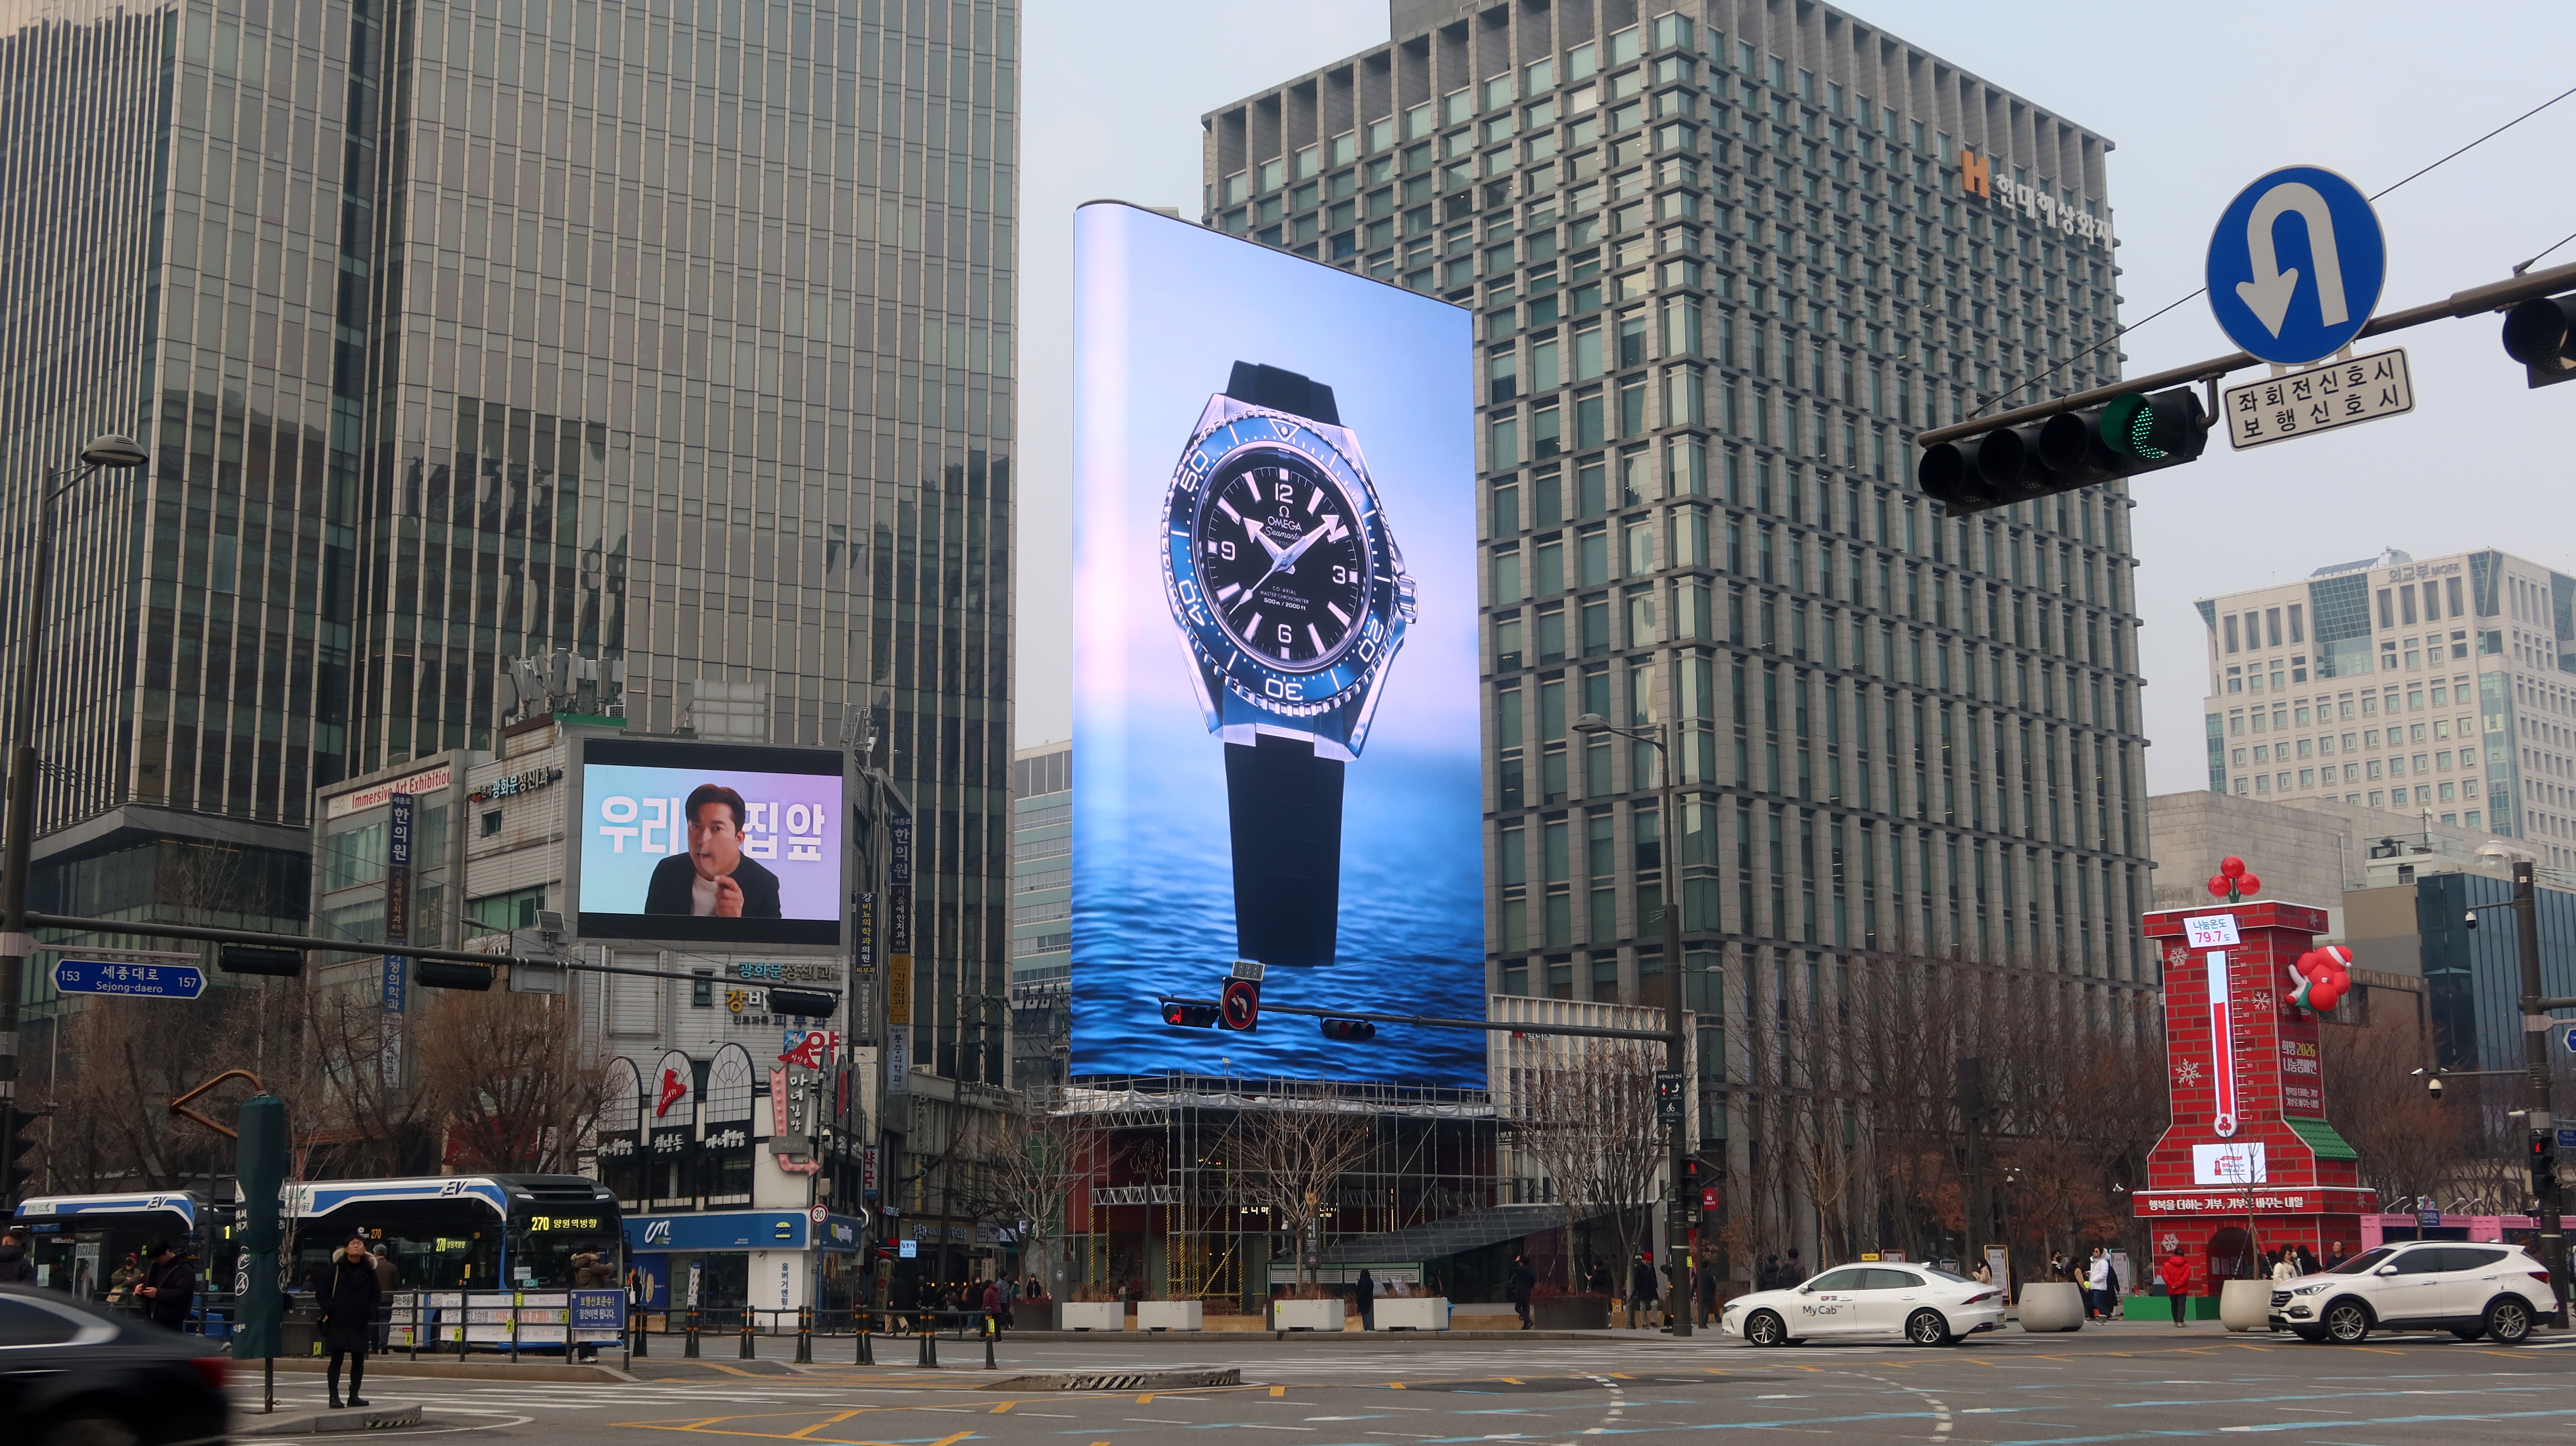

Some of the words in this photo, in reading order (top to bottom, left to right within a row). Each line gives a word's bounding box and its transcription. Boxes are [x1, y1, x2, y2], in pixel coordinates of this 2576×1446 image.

[1996, 171, 2113, 254] 현대해상화재
[1180, 448, 1209, 493] 50
[1275, 482, 1293, 504] 12
[1268, 516, 1302, 532] OMEGA
[1264, 526, 1300, 540] Seamaste
[1221, 540, 1235, 560] 9
[1332, 565, 1346, 585] 3
[2388, 563, 2429, 583] 외교부
[2431, 562, 2461, 577] MOFA
[1178, 578, 1206, 627] 40
[1278, 593, 1309, 604] CHRONOMETER
[1278, 624, 1292, 644] 6
[1358, 618, 1384, 663] 20
[1265, 678, 1303, 701] 30
[352, 787, 392, 809] Immersive
[395, 780, 407, 794] Art
[393, 797, 411, 805] 세종로
[599, 796, 680, 855] 우리
[393, 808, 410, 861] 한의원
[894, 828, 910, 878] 한의원
[2193, 919, 2227, 931] 나눔온도
[2195, 931, 2222, 943] 79.7
[61, 970, 80, 981] 153
[101, 966, 159, 981] 세종대로
[96, 981, 162, 994] Sejong-daero
[178, 977, 197, 988] 157
[773, 1014, 827, 1029] 피부과
[2282, 1040, 2295, 1056] 희망
[2296, 1043, 2316, 1057] 2026
[894, 1034, 902, 1083] 통증의학과
[2283, 1058, 2317, 1075] 나눔캠페인
[2286, 1086, 2297, 1096] 행복을
[789, 1073, 808, 1131] 마녀김밥
[654, 1133, 684, 1153] 청담동
[864, 1149, 875, 1188] 약국
[445, 1181, 468, 1195] EV
[148, 1196, 167, 1209] EV
[2149, 1199, 2175, 1211] 행복을
[2176, 1199, 2203, 1210] 더하는
[2204, 1199, 2226, 1210] 기부,
[2227, 1198, 2254, 1209] 기부로
[2255, 1197, 2283, 1208] 바꾸는
[2285, 1197, 2303, 1208] 내일
[814, 1210, 824, 1219] 30
[531, 1217, 549, 1231] 270
[553, 1218, 597, 1229] 양원역방향
[370, 1229, 382, 1239] 270
[436, 1238, 446, 1252] 270
[447, 1240, 466, 1250] 양원역방향
[580, 1296, 614, 1307] 보행신호준수!
[579, 1309, 598, 1319] 잠깐이면
[1803, 1306, 1817, 1316] My
[1819, 1305, 1836, 1314] Cab
